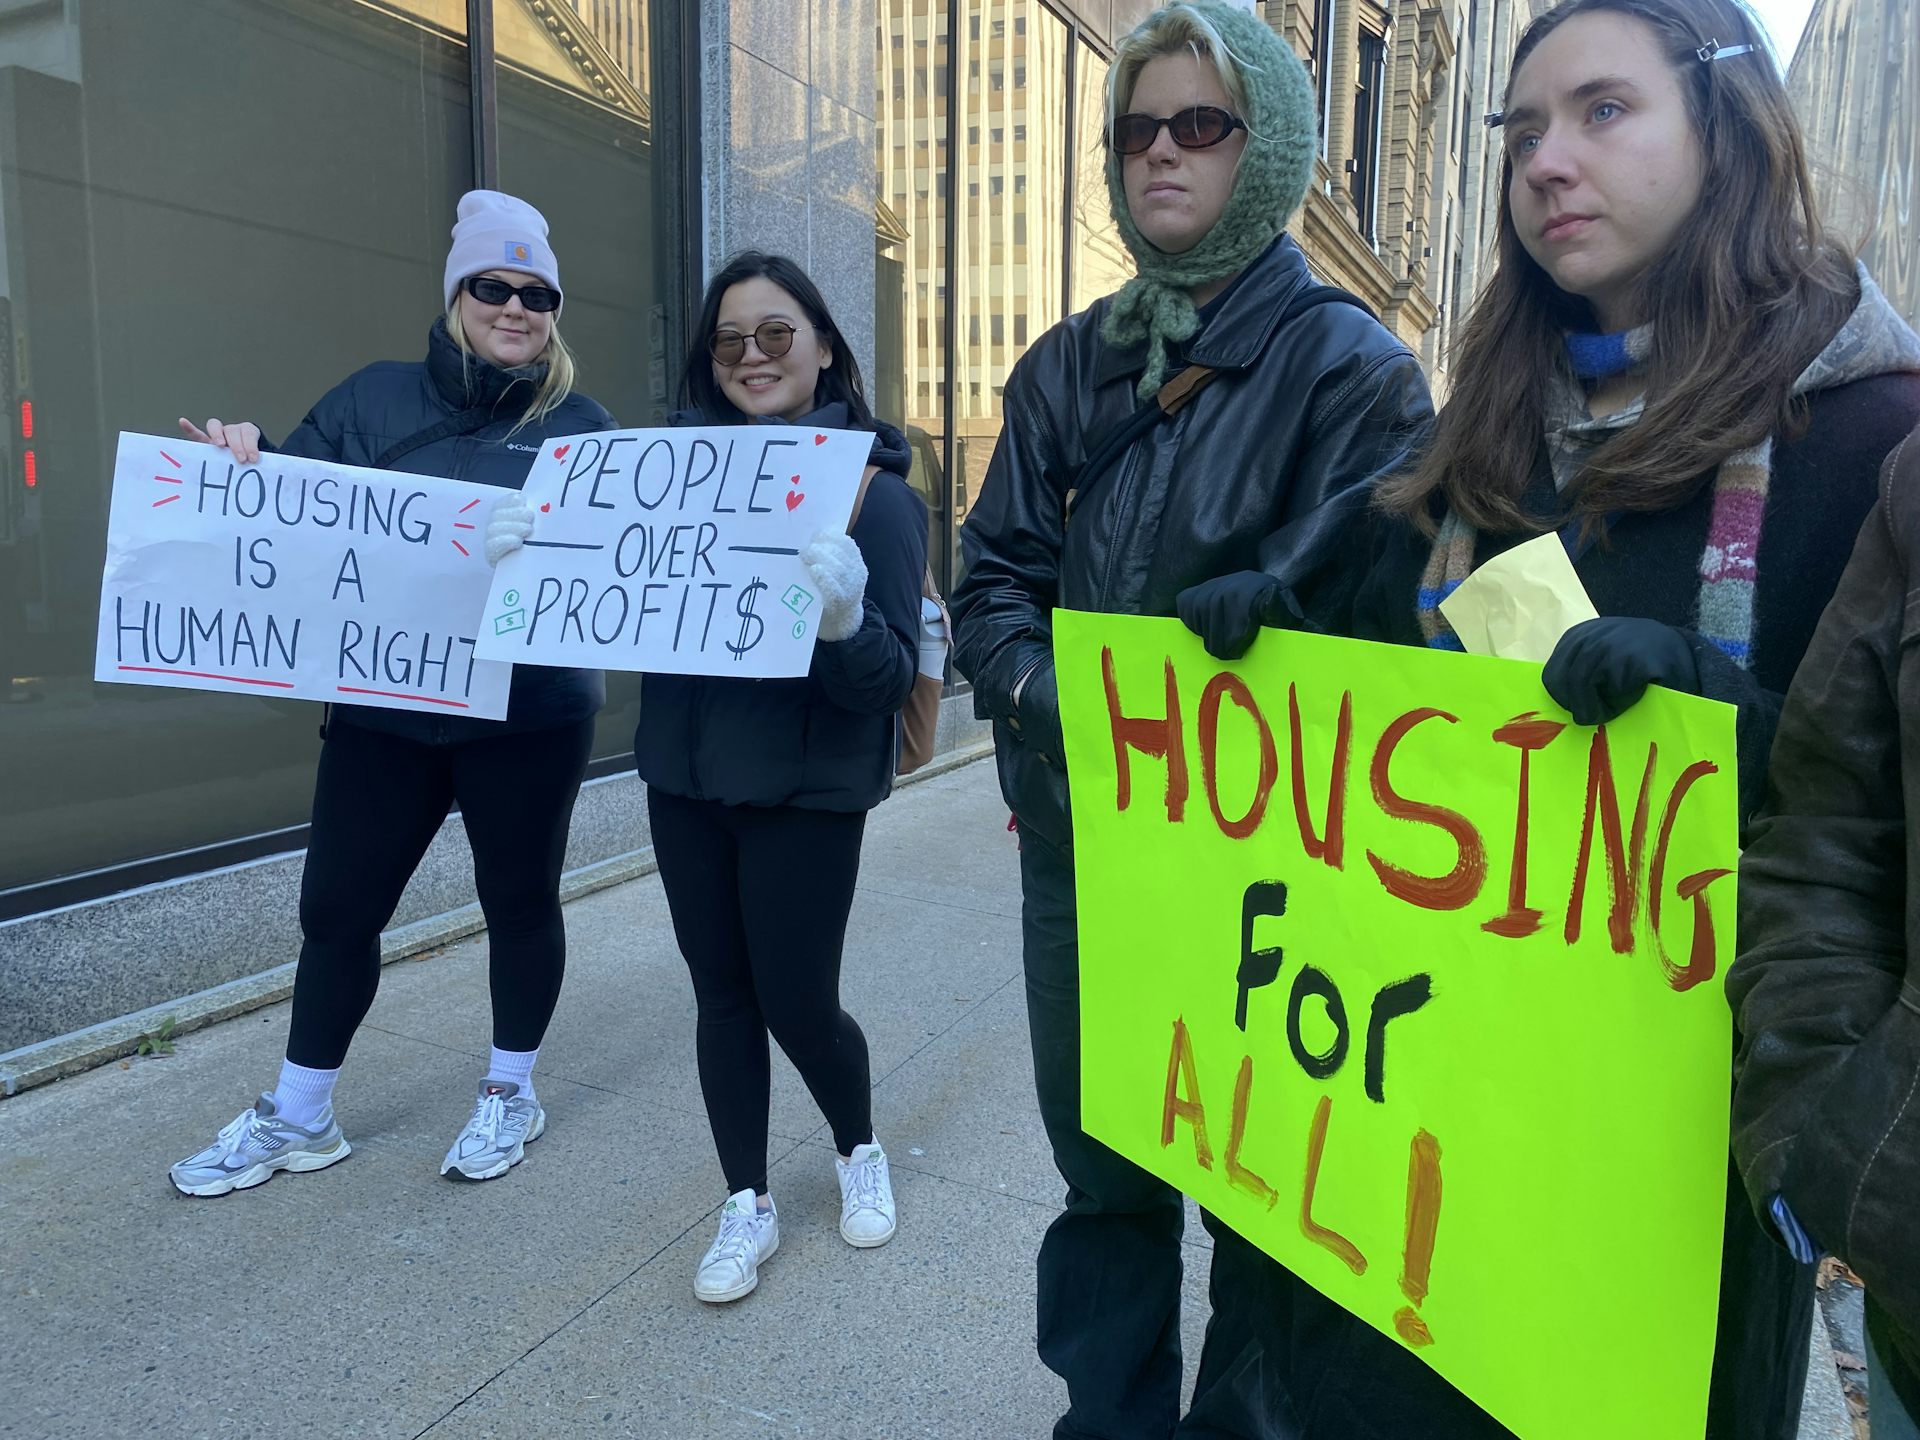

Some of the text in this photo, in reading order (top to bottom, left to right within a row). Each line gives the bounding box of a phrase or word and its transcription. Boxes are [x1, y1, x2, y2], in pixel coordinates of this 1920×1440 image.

[515, 443, 541, 453] Colum
[558, 437, 799, 514] PEOPLE
[199, 460, 432, 545] HOUSING
[233, 535, 366, 604] IS A
[613, 521, 719, 580] OVER
[117, 597, 477, 698] HUMAN RIGHT
[525, 575, 769, 662] PROFIT$
[1101, 643, 1736, 993] HOUSING
[1160, 1013, 1444, 1348] ALL!
